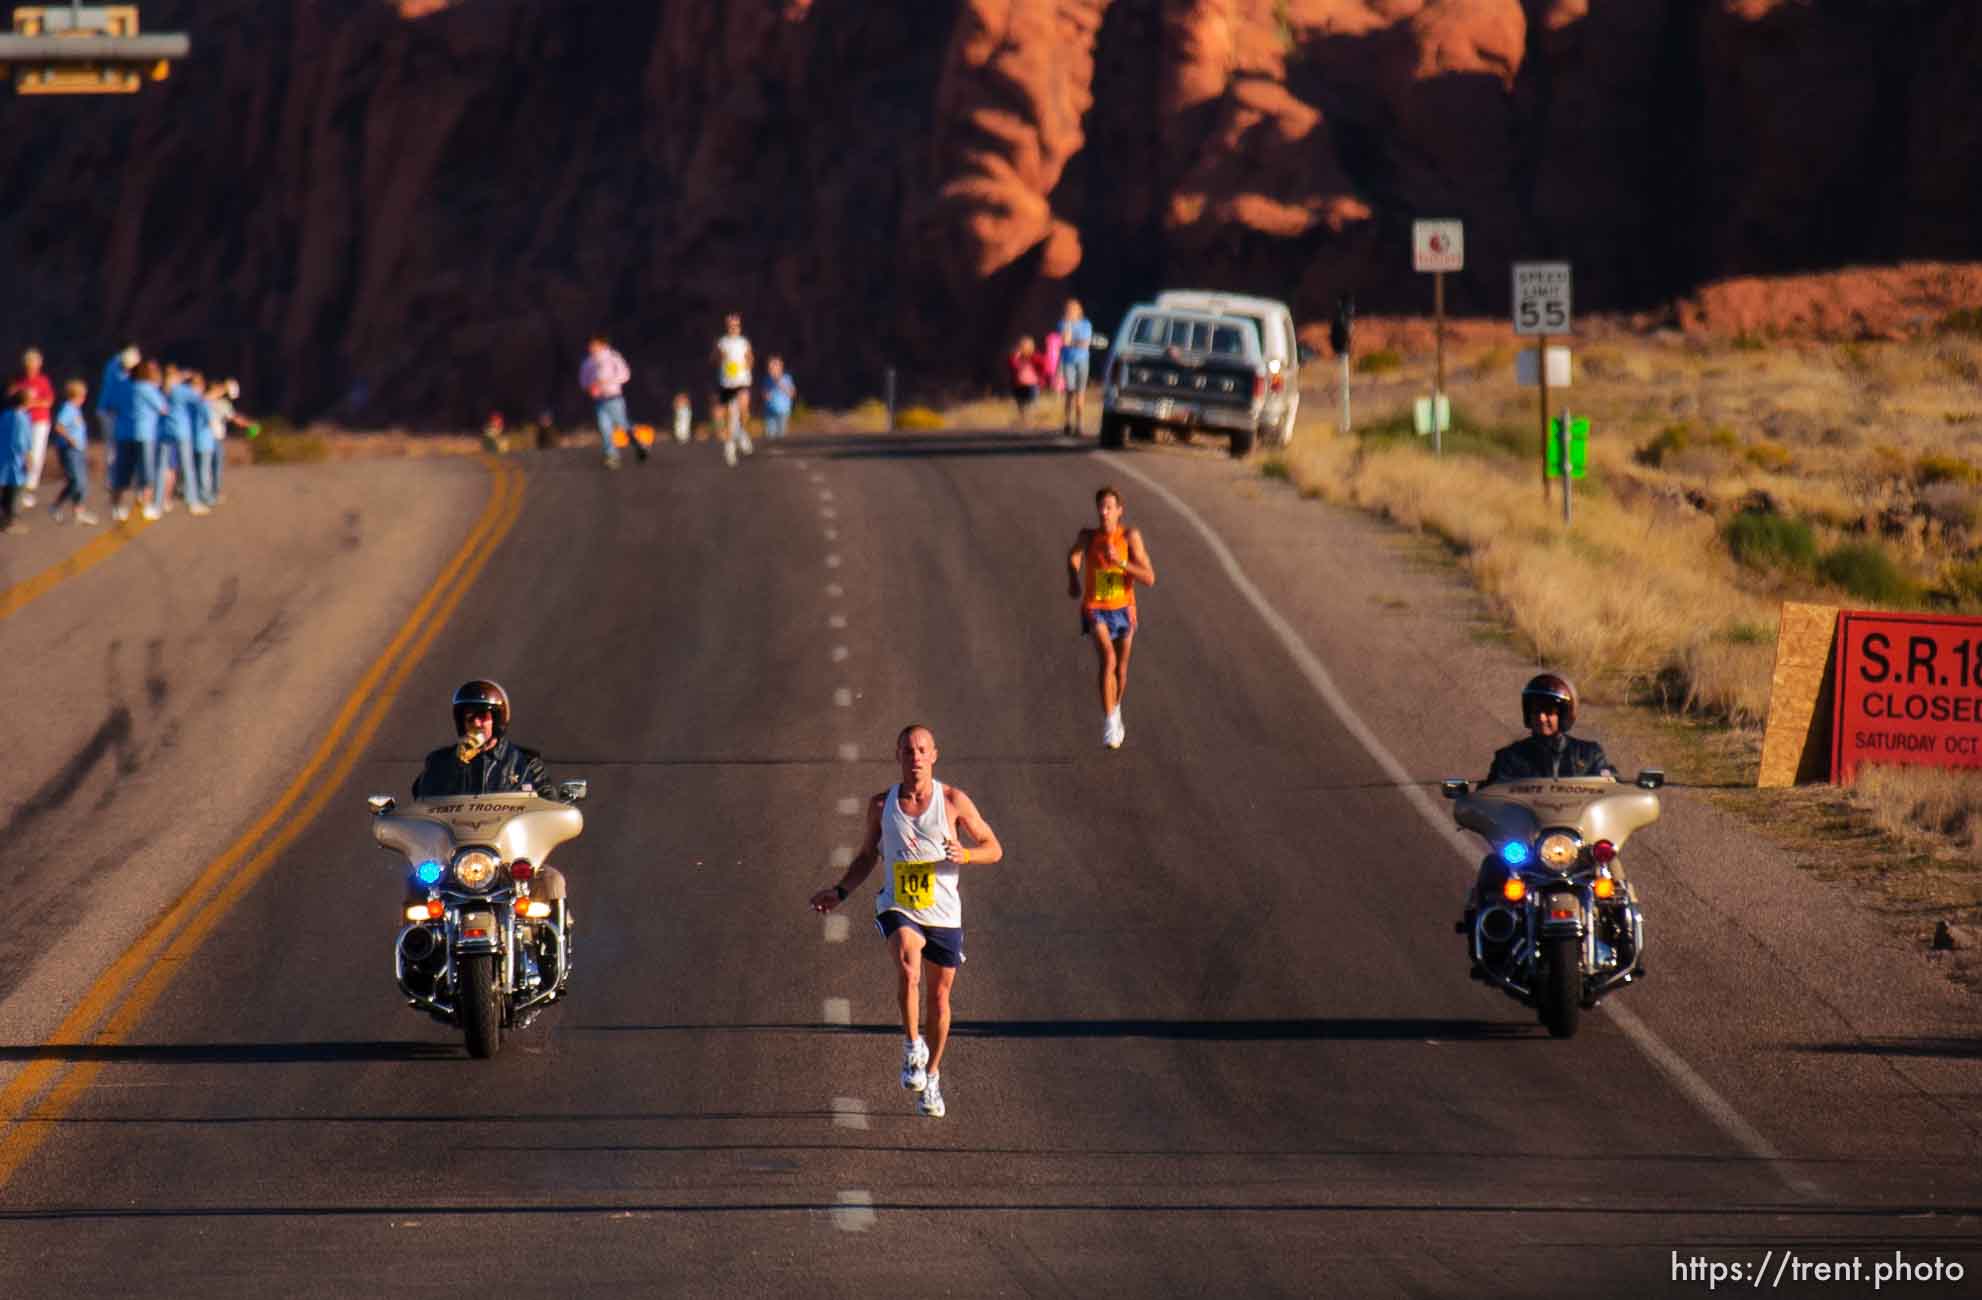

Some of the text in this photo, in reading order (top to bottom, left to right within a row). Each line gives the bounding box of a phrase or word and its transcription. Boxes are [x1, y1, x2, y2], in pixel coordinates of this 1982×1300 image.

[1521, 302, 1565, 328] 55
[1855, 731, 1977, 755] SATURDAY OCT
[428, 802, 526, 813] STATE TROOPER
[901, 874, 929, 894] 104
